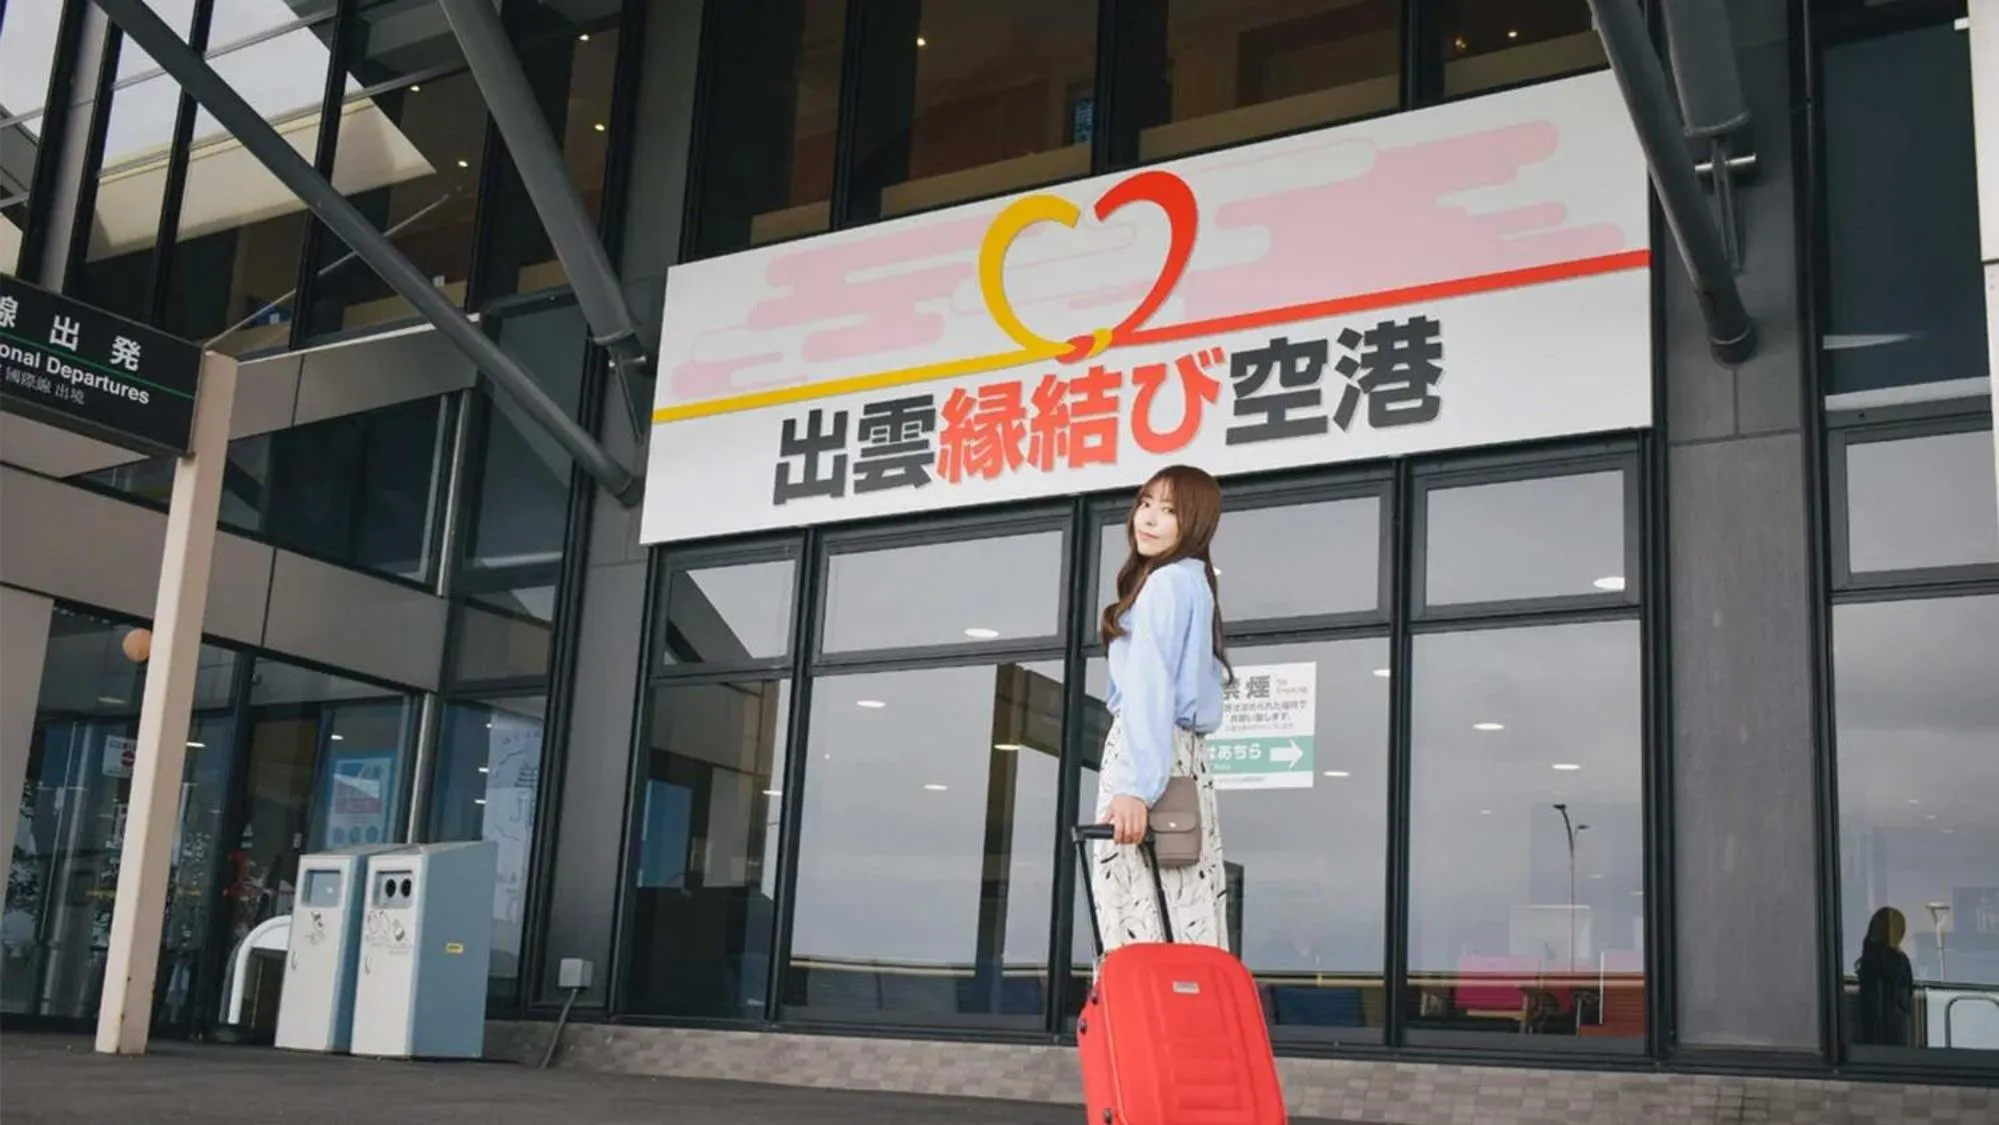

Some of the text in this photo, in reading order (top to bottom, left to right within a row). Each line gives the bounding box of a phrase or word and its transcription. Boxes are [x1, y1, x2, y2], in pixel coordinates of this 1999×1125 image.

[46, 356, 150, 404] Departures
[773, 315, 1445, 505] 出雲縁結び空港
